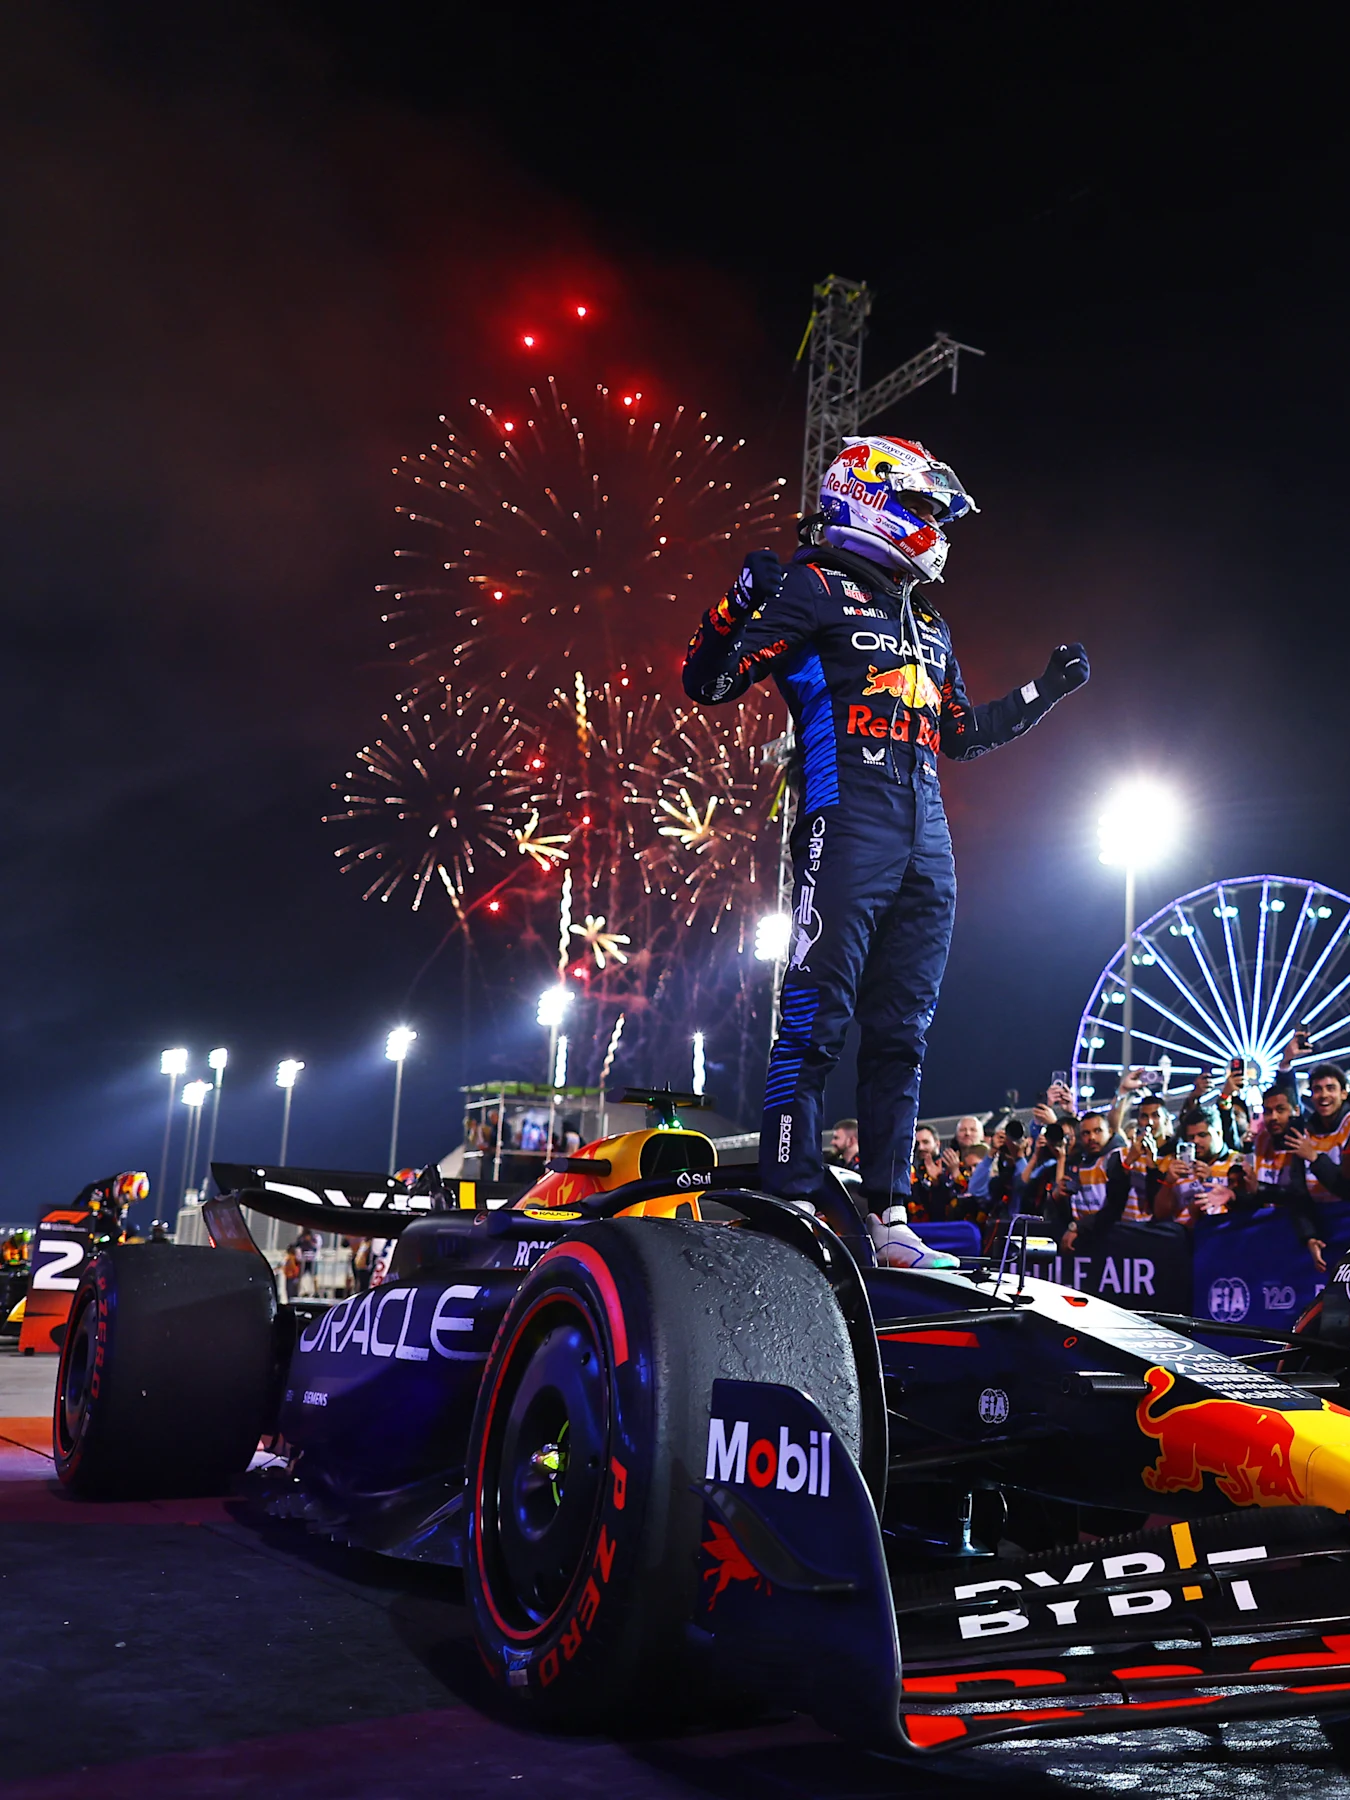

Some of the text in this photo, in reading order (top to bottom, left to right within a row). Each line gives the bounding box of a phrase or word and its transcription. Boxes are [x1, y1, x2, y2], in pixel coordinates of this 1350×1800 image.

[826, 473, 889, 511] Red Bull
[843, 606, 876, 618] Mobil
[846, 704, 911, 742] Red
[692, 1171, 712, 1185] Sui
[32, 1239, 84, 1291] 2
[1098, 1256, 1156, 1296] AIR
[300, 1284, 488, 1361] ORACLE
[1142, 1353, 1231, 1362] zoom
[302, 1391, 329, 1407] SIEMENS
[1220, 1390, 1290, 1400] Mobil
[705, 1418, 832, 1498] Mobil
[538, 1455, 628, 1688] P ZERO
